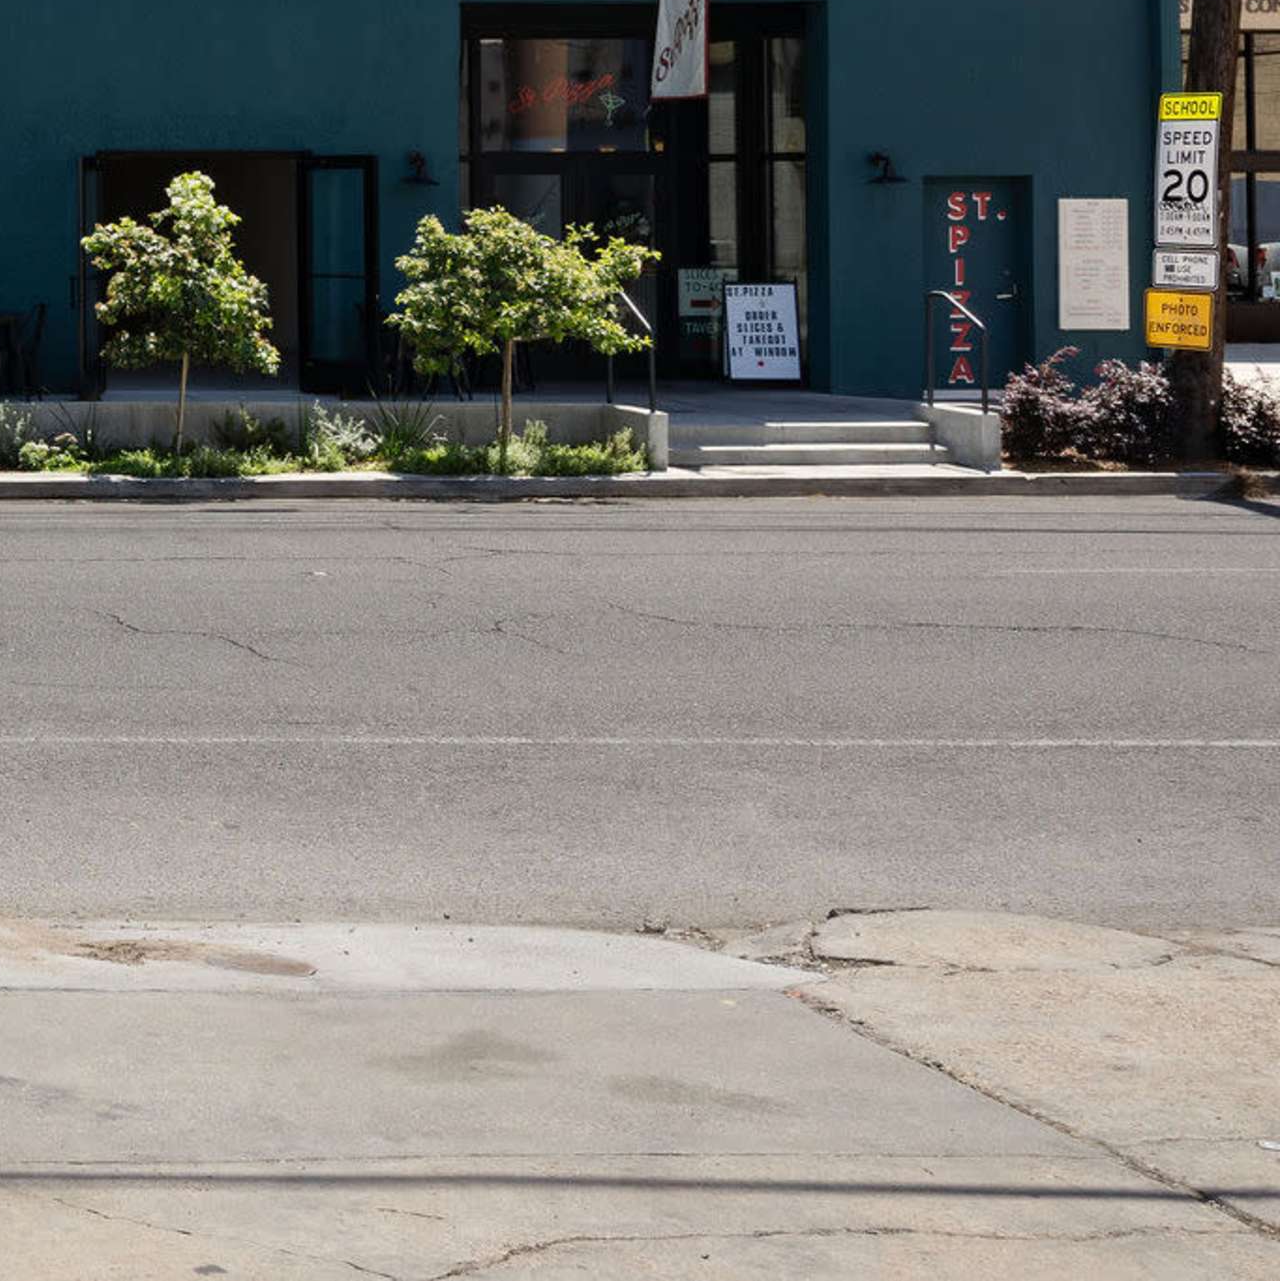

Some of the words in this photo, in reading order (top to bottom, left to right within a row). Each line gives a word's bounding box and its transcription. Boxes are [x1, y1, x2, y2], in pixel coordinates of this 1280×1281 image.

[1164, 100, 1216, 116] SCHOOL
[1163, 130, 1213, 146] SPEED
[1166, 150, 1207, 165] LIMIT
[1162, 169, 1209, 203] 20
[947, 191, 1007, 221] ST.
[1162, 255, 1179, 264] CELL
[1182, 255, 1208, 265] PHONE
[948, 225, 976, 385] PIZZA
[1161, 303, 1199, 317] PHOTO
[745, 310, 778, 321] ORDER
[737, 323, 773, 333] SLICES
[1149, 321, 1208, 337] ENFORCED
[743, 335, 787, 345] TAKEOUT
[732, 347, 743, 357] AT
